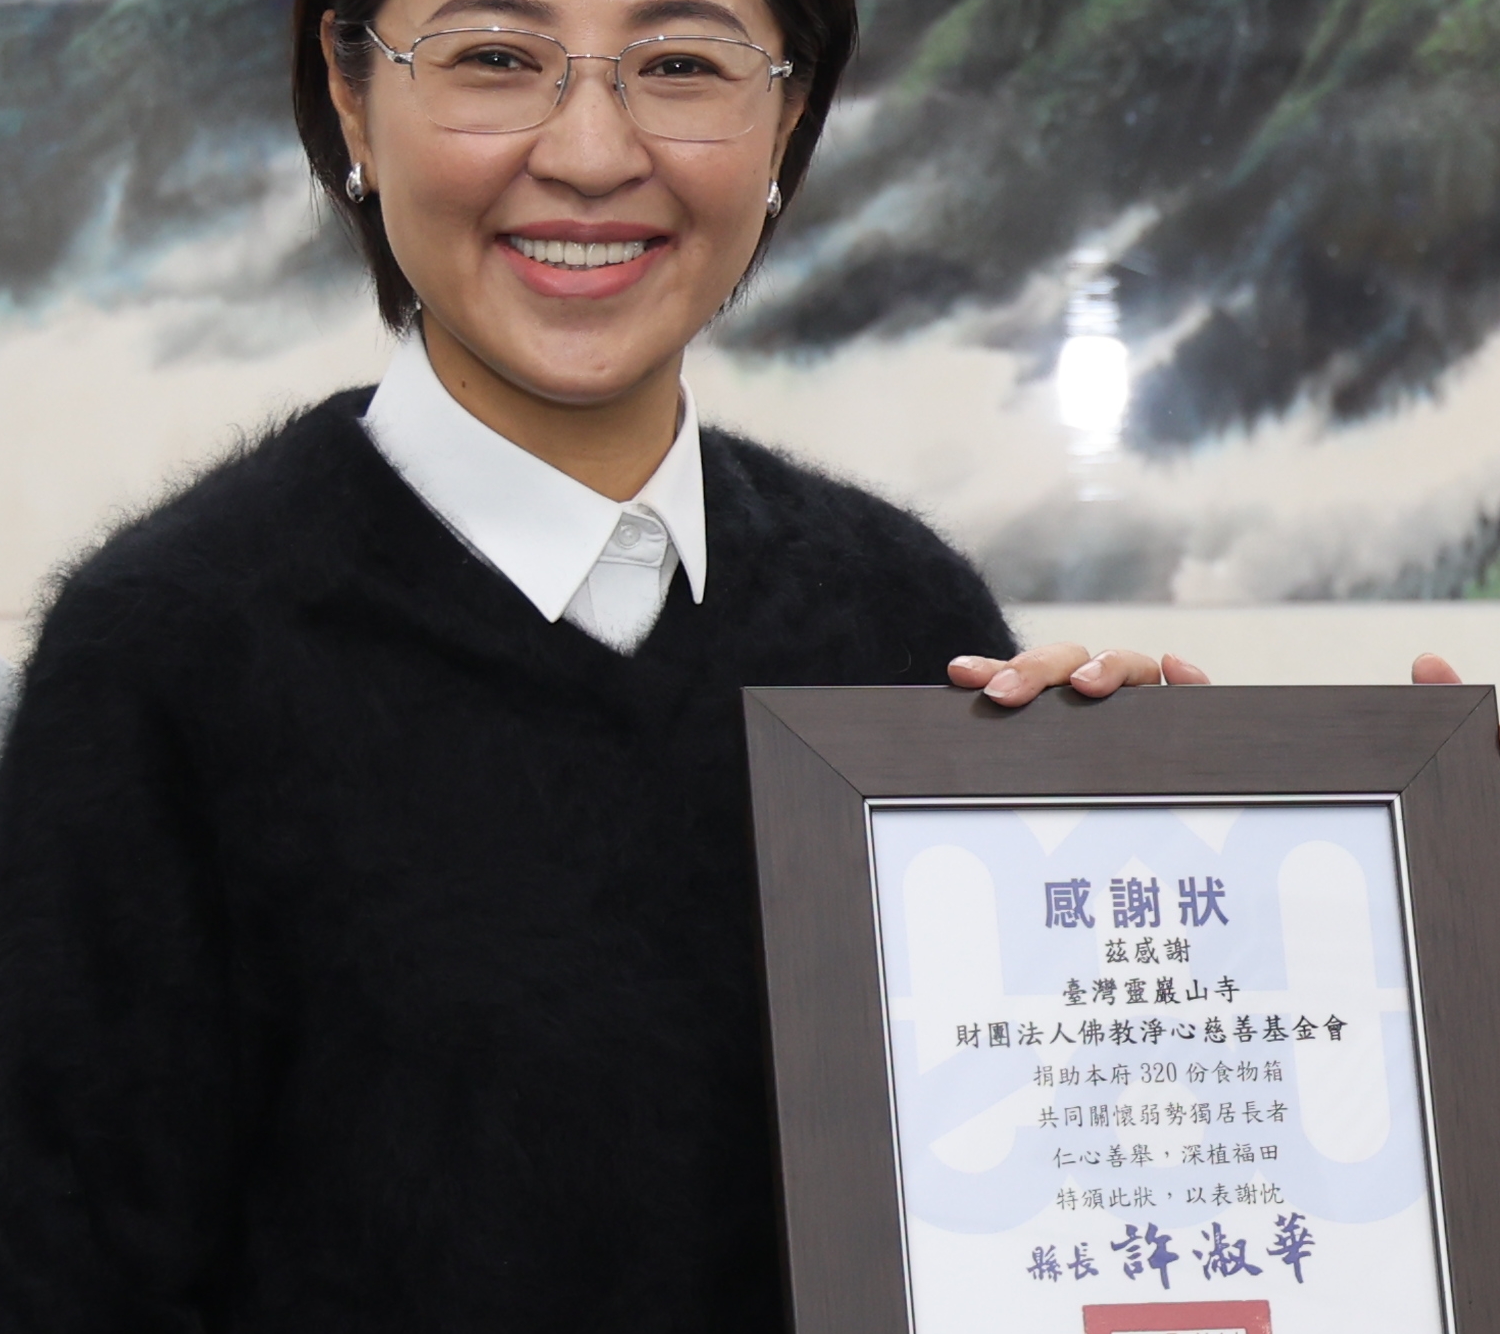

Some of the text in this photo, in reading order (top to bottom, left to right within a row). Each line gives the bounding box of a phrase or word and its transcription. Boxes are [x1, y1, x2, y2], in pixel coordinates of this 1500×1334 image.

[1043, 876, 1230, 930] 感謝狀
[1104, 936, 1192, 965] 茲感謝
[1062, 974, 1241, 1008] 臺灣靈巖山寺
[955, 1013, 1349, 1049] 財團法人佛教淨心慈善基金會
[1038, 1099, 1289, 1129] 共同關懷弱勢獨居長者
[1025, 1211, 1317, 1290] 縣長 許淑華
